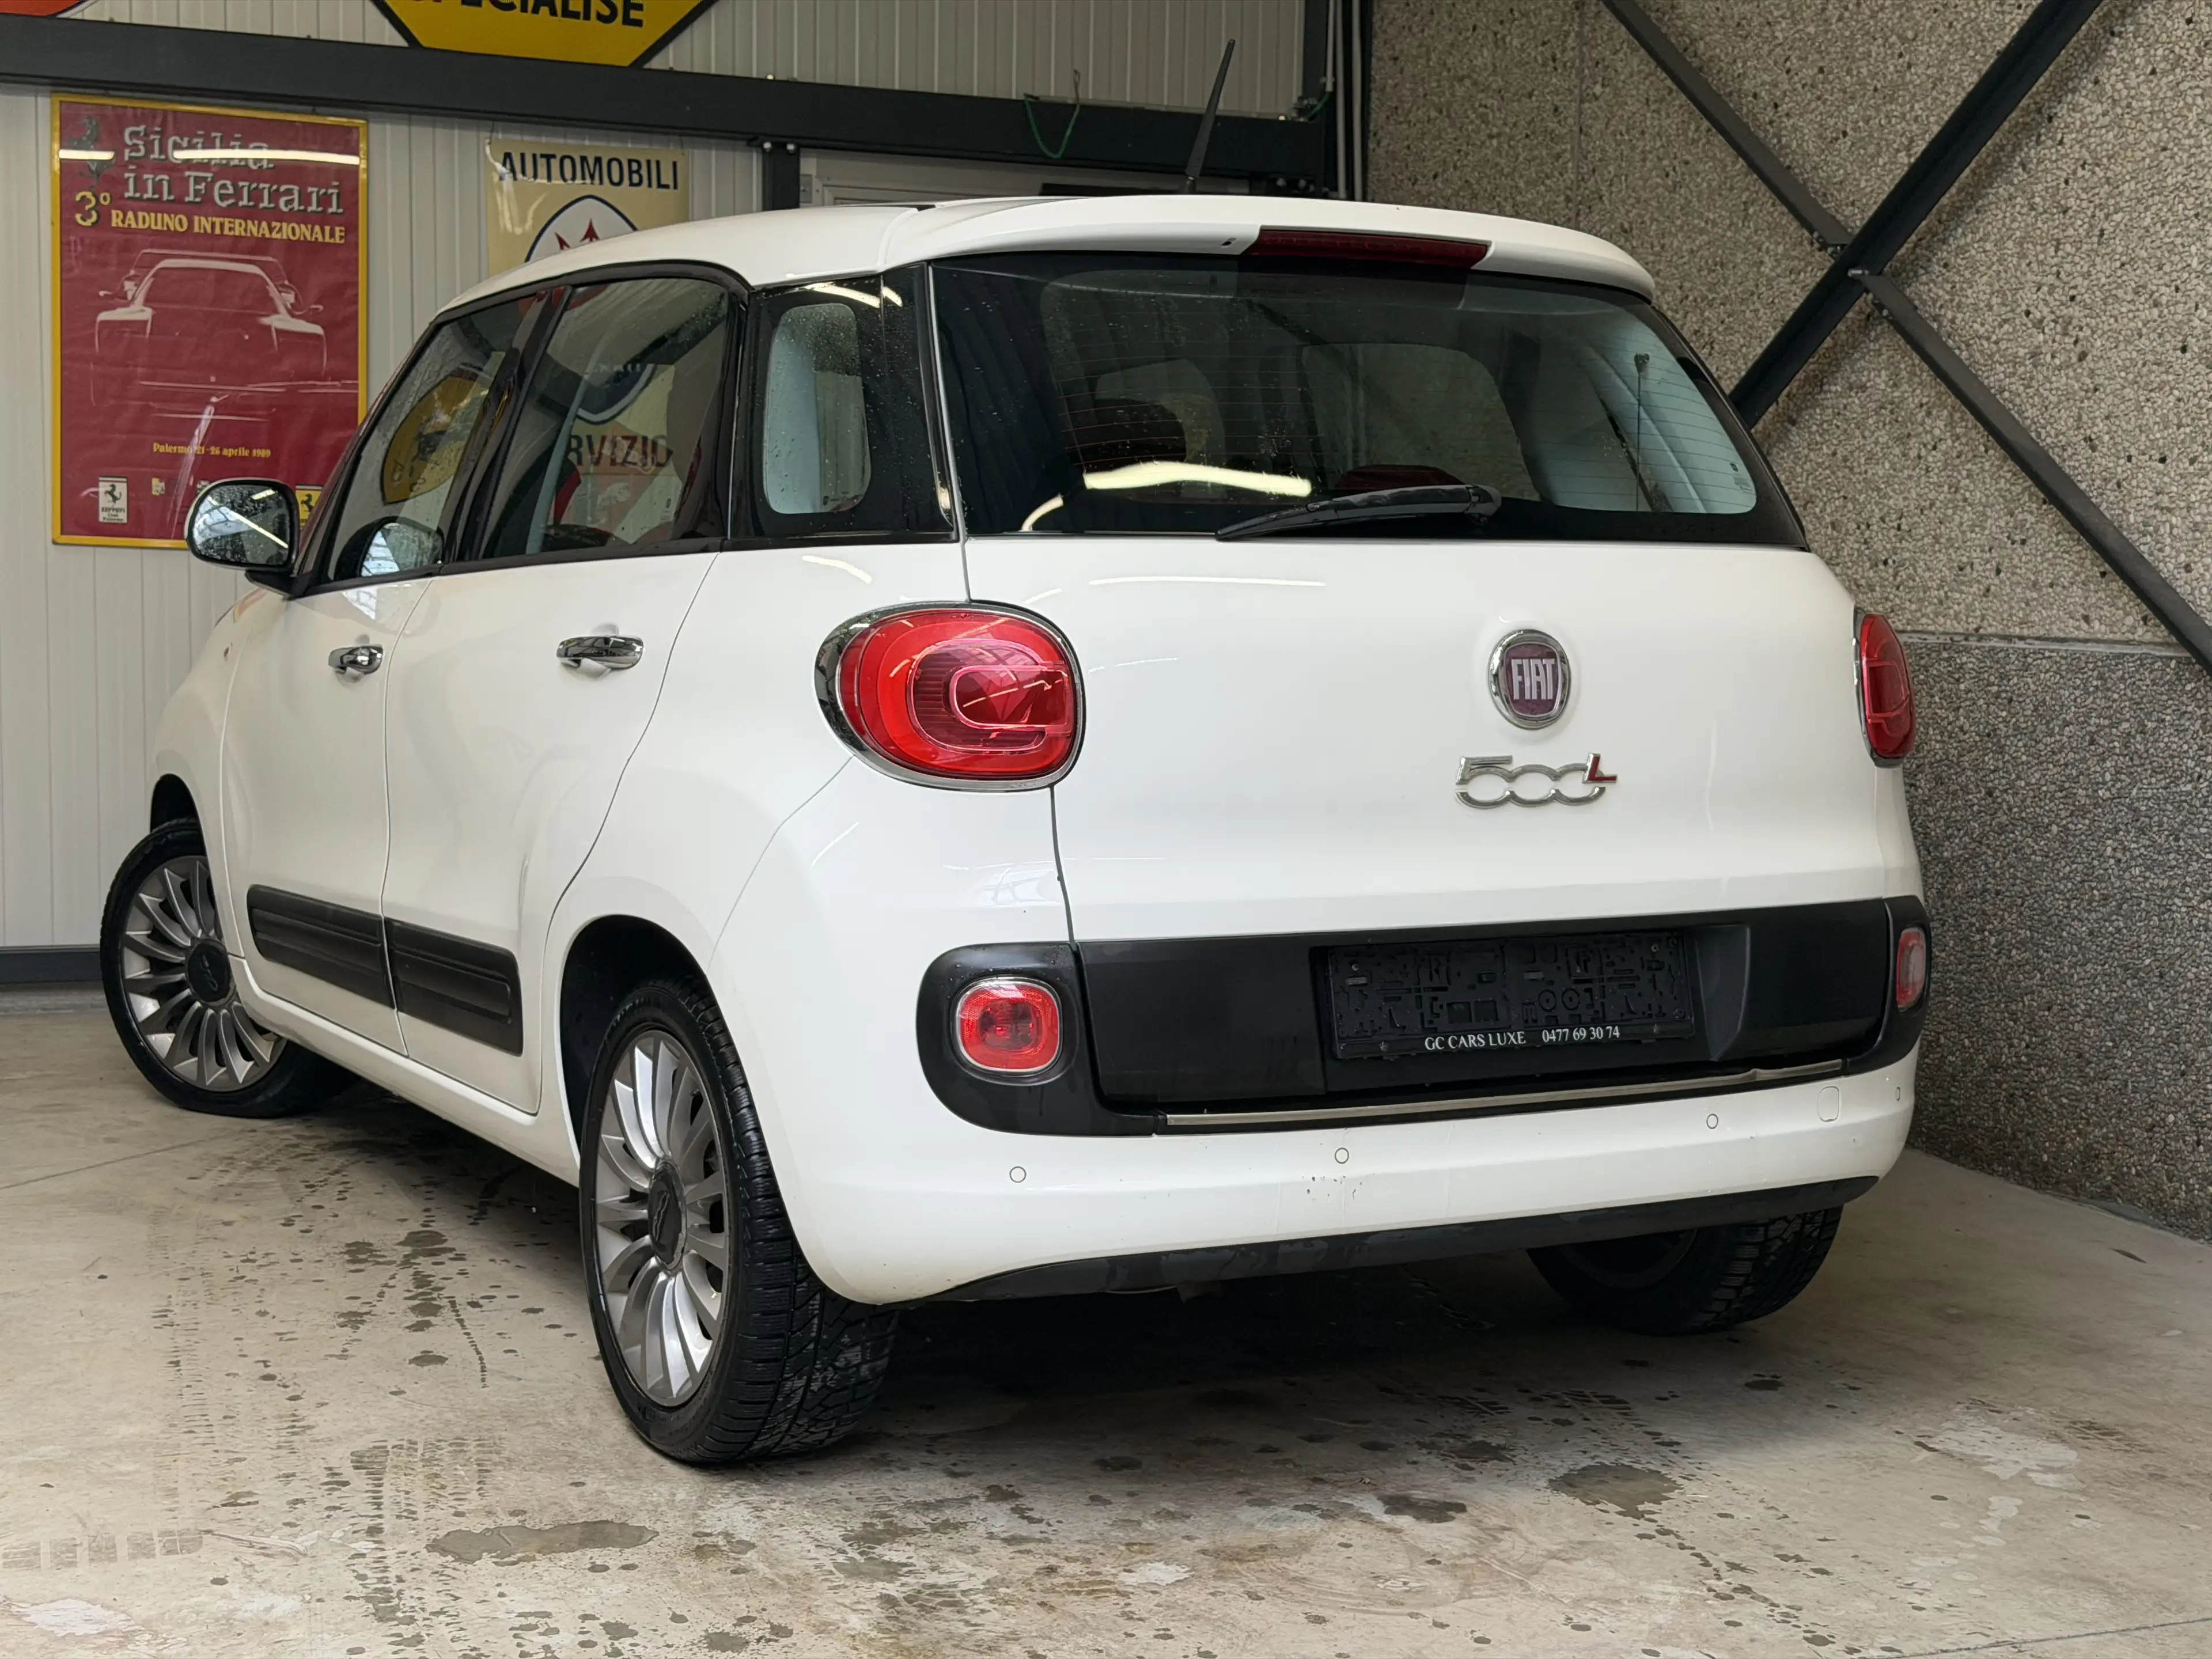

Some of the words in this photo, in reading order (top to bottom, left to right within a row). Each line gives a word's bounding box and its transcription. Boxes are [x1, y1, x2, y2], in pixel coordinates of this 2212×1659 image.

[123, 125, 275, 169] Sicilia
[123, 166, 175, 202] in
[184, 171, 344, 214] Ferrari
[500, 151, 679, 190] AUTOMOBILI
[111, 209, 188, 232] RADUNO
[194, 216, 344, 244] INTERNAZIONALE
[153, 442, 192, 454] Palermo
[222, 446, 249, 457] aprile
[1511, 658, 1555, 700] FIAT
[1425, 1036, 1444, 1051] GC
[1448, 1034, 1486, 1049] CARS
[1488, 1031, 1526, 1046] LUXE
[1541, 1028, 1569, 1043] 0477
[1573, 1027, 1586, 1041] 69
[1589, 1027, 1604, 1040] 30
[1605, 1025, 1620, 1039] 74
